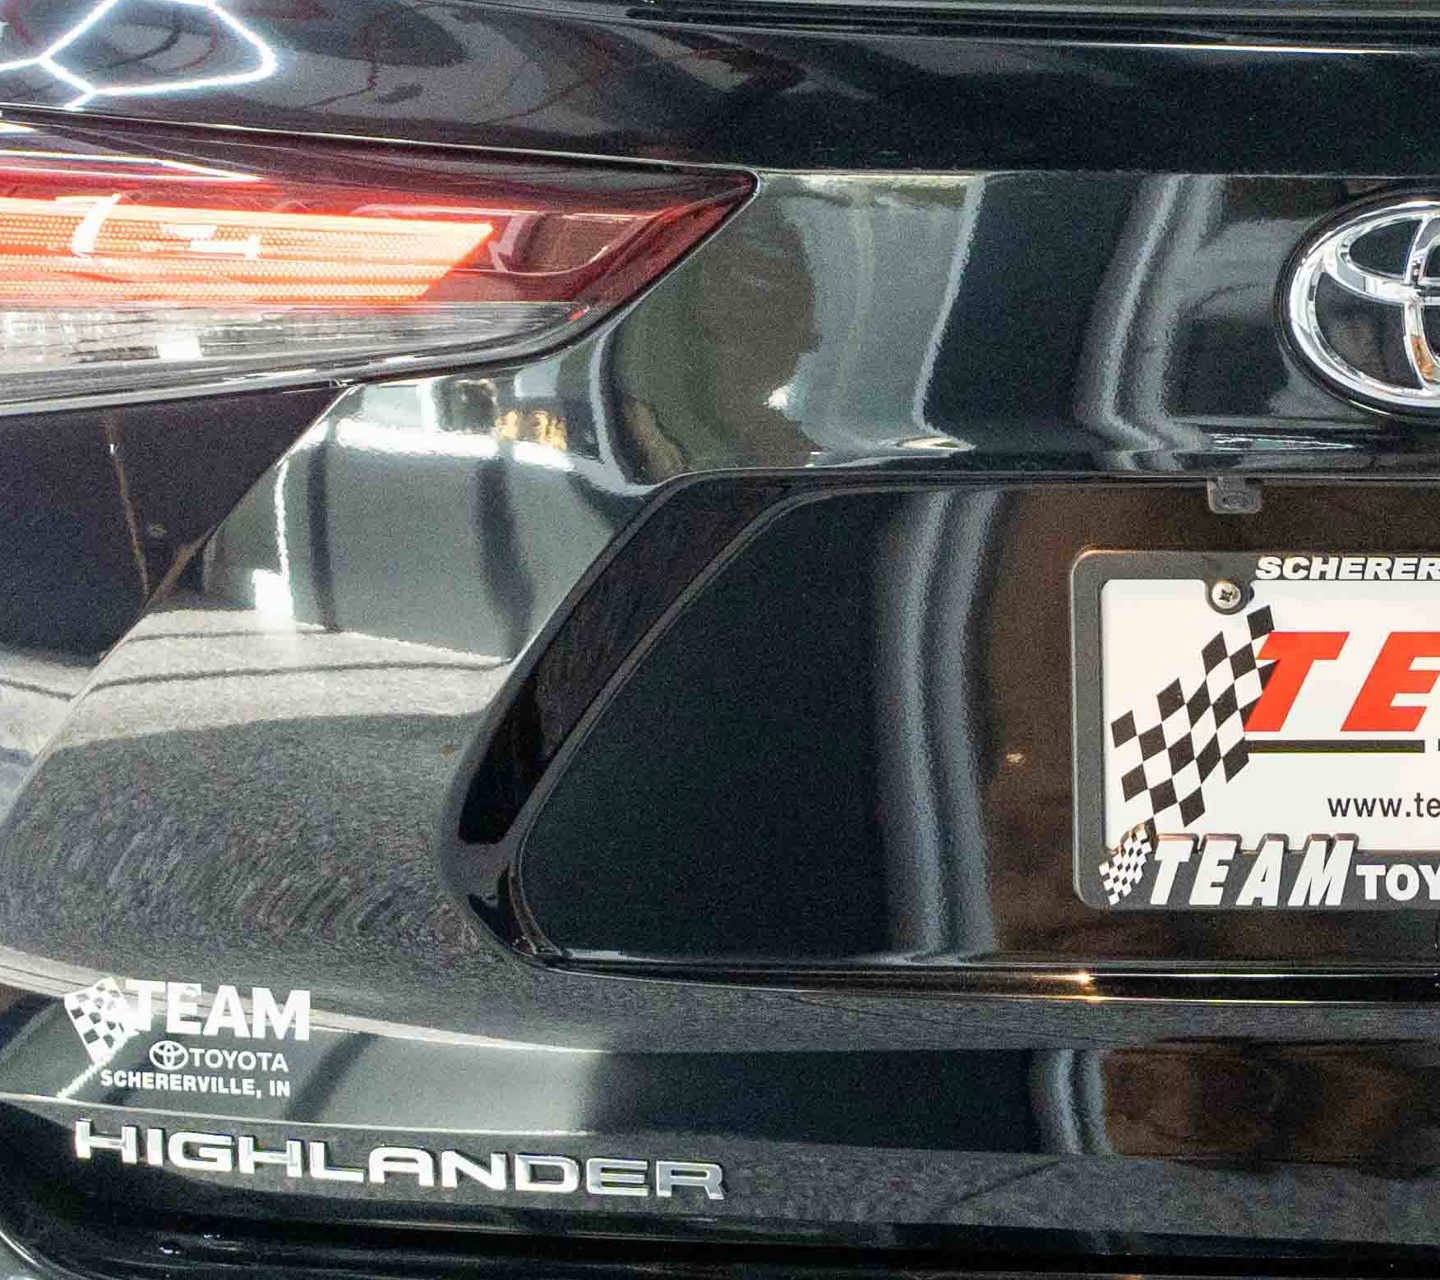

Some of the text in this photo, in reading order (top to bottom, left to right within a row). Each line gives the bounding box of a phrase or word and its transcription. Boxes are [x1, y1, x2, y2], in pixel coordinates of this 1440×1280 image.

[1150, 839, 1356, 907] TEAM
[124, 979, 311, 1042] TEAM
[100, 1070, 291, 1098] SCHERERVILLE, IN
[189, 1050, 288, 1072] TOYOTA
[74, 1120, 725, 1200] HIGHLANDER
